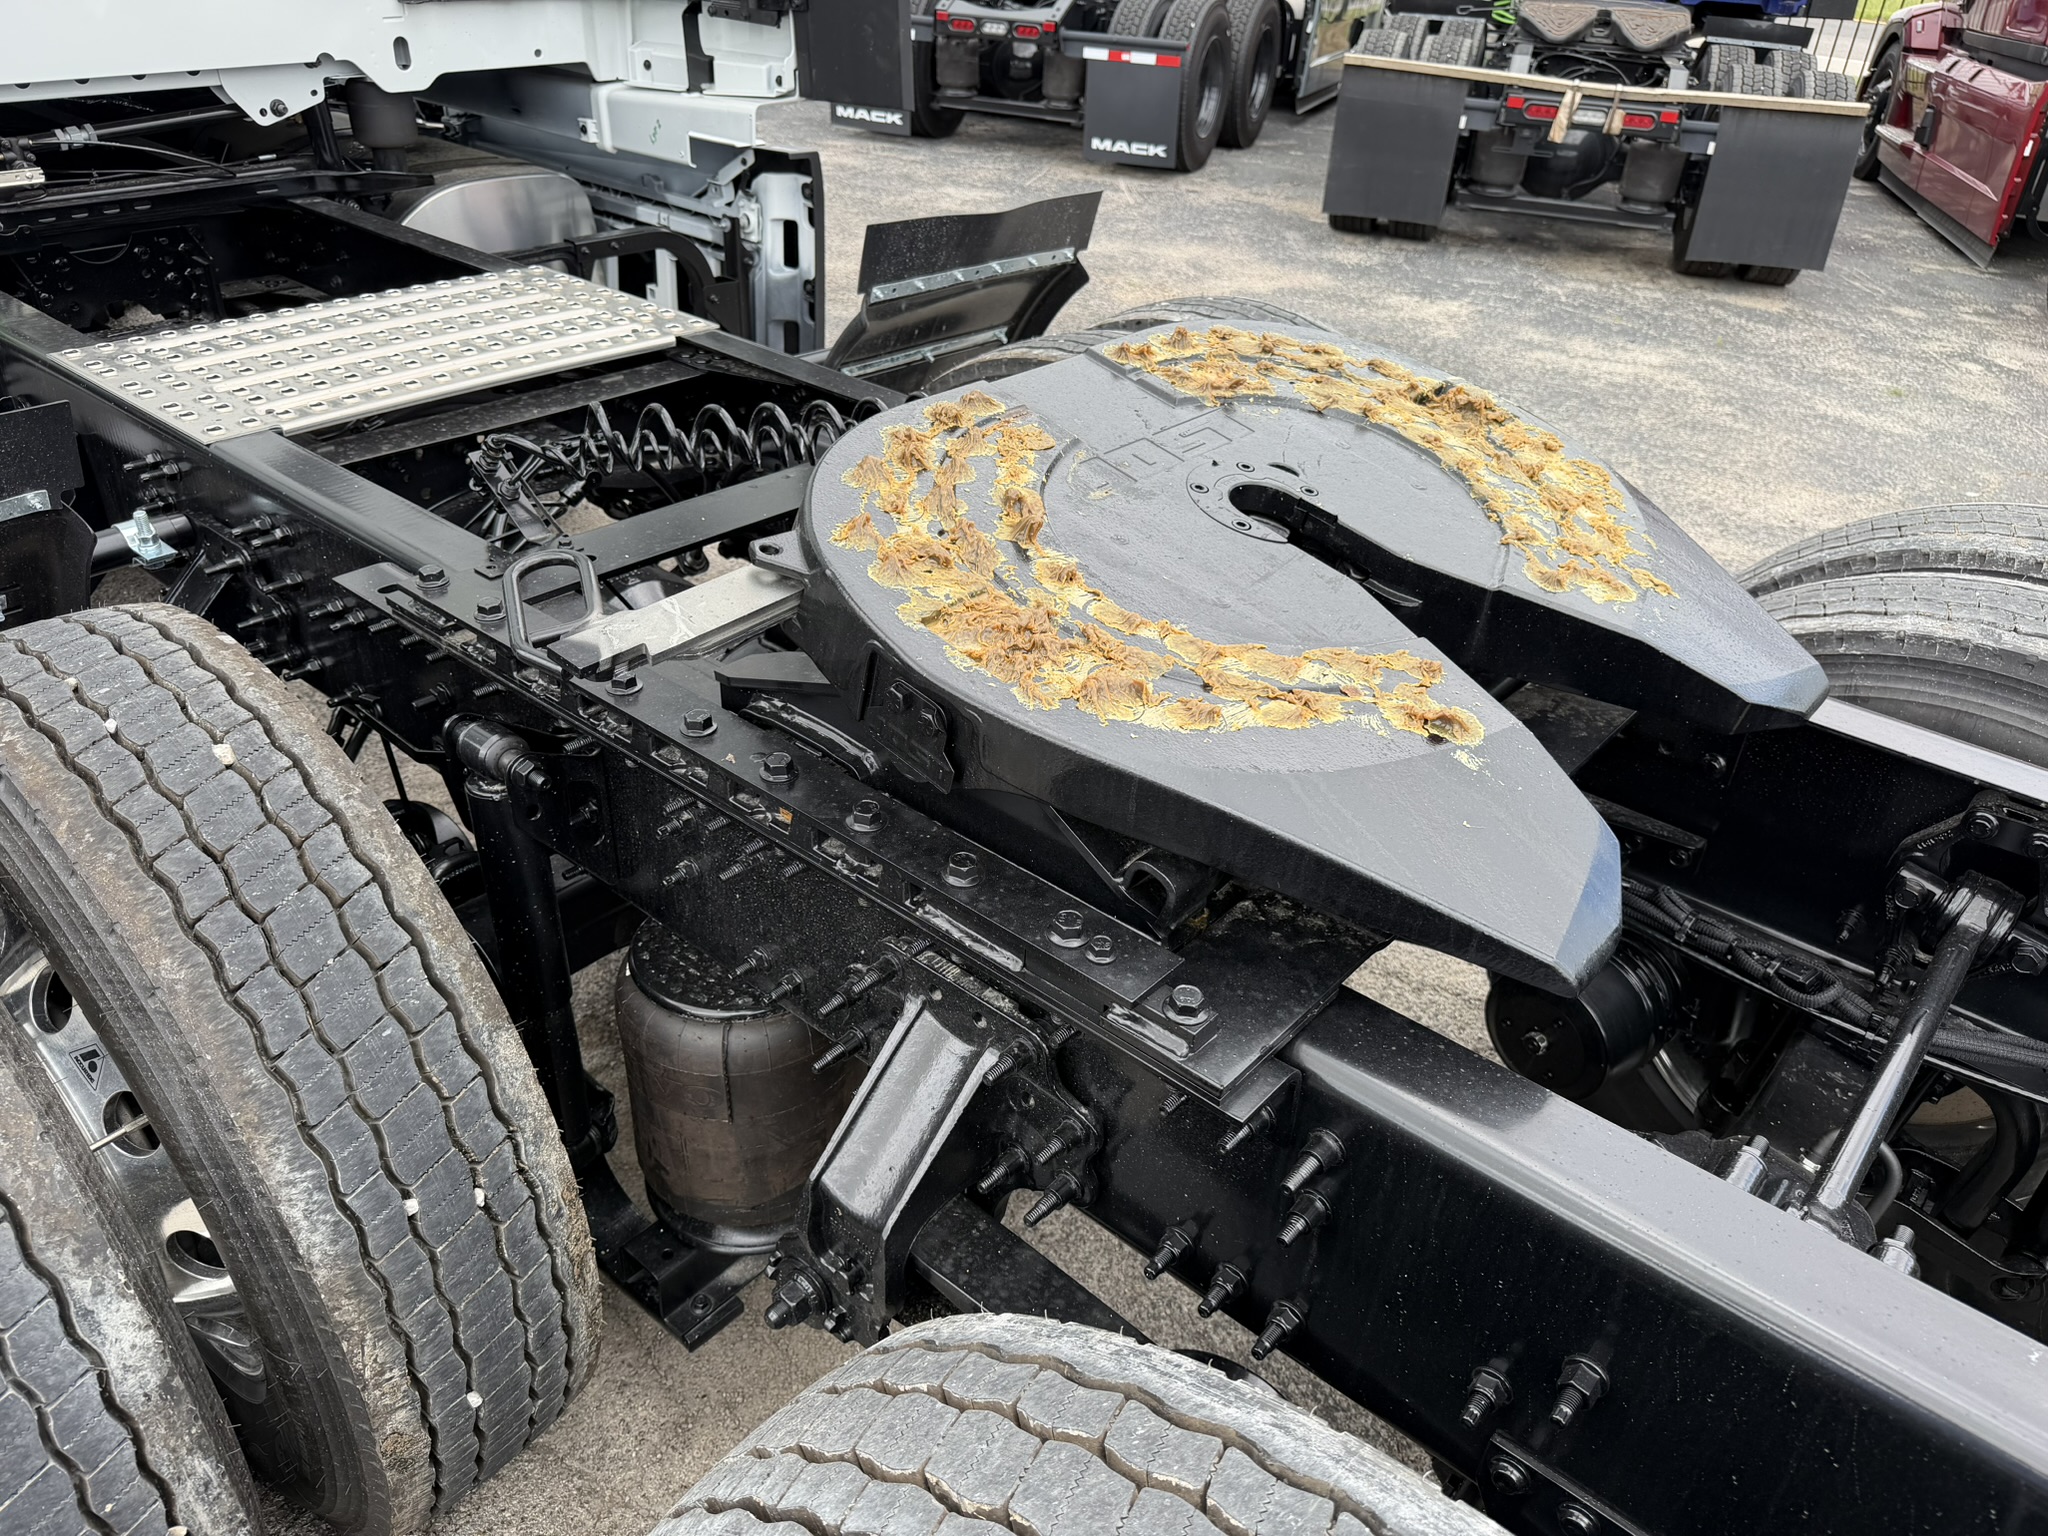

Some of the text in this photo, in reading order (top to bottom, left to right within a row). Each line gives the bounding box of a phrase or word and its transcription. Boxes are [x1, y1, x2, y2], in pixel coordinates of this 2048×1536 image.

[836, 105, 903, 126] MACK
[1091, 137, 1168, 158] MACK
[74, 1055, 95, 1083] ACCURIDE
